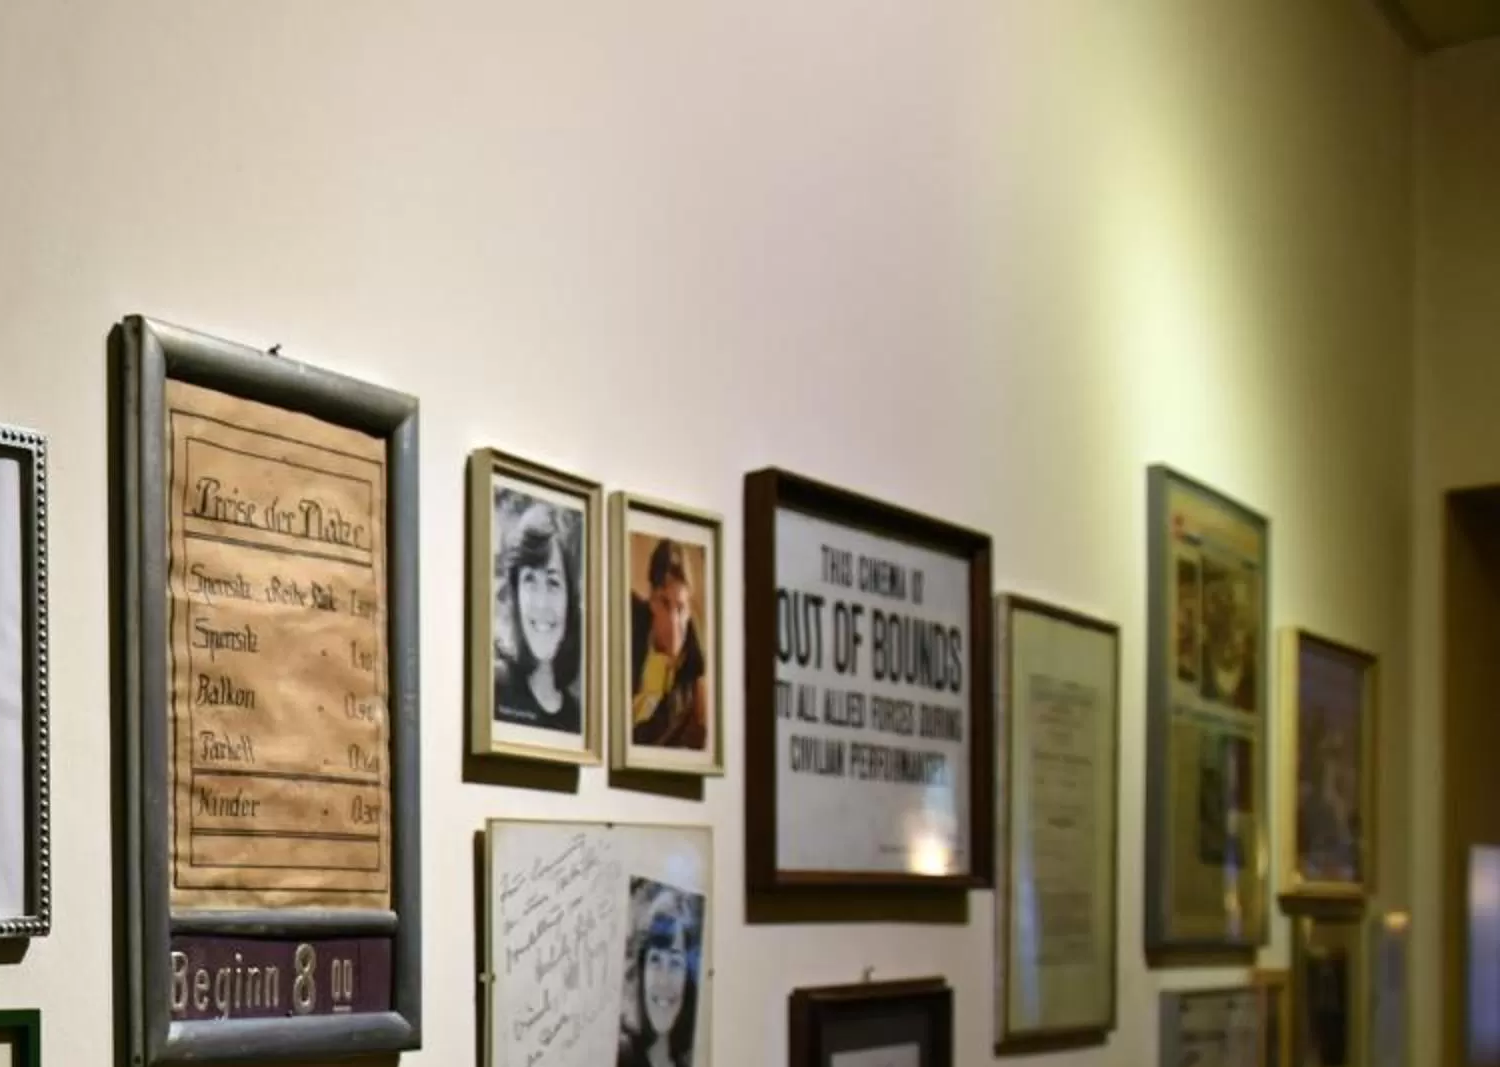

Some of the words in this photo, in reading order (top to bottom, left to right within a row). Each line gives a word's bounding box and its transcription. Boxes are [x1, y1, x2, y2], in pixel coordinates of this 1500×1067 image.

[264, 495, 297, 533] der
[821, 543, 853, 591] THIS
[859, 554, 906, 600] CINEMA
[775, 587, 825, 671] OUT
[832, 599, 864, 676] OF
[872, 607, 963, 695] BOUNDS
[197, 673, 256, 711] Balkon
[170, 950, 280, 1023] Beginn
[292, 942, 317, 1016] 8
